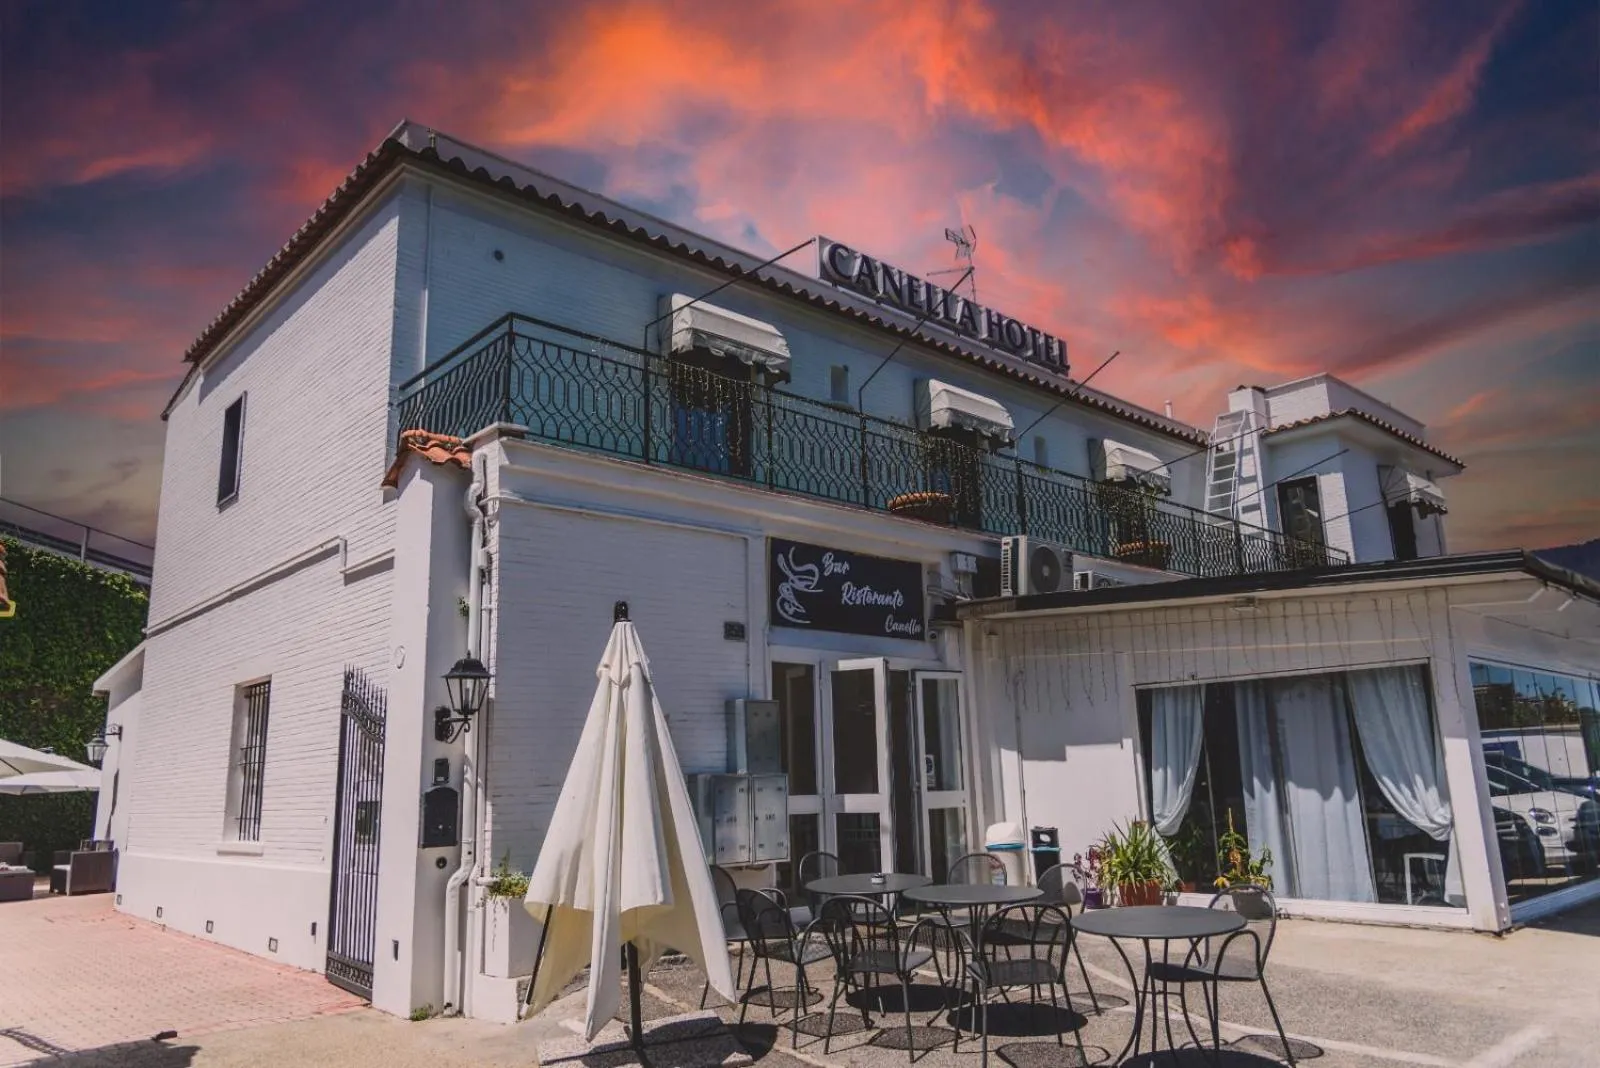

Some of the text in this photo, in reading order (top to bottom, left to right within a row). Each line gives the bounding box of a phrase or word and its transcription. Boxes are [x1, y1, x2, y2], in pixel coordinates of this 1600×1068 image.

[822, 243, 1069, 370] CANELLA HOTEL
[821, 552, 850, 576] Bar
[841, 581, 904, 609] Ristorante
[885, 614, 922, 635] Canella
